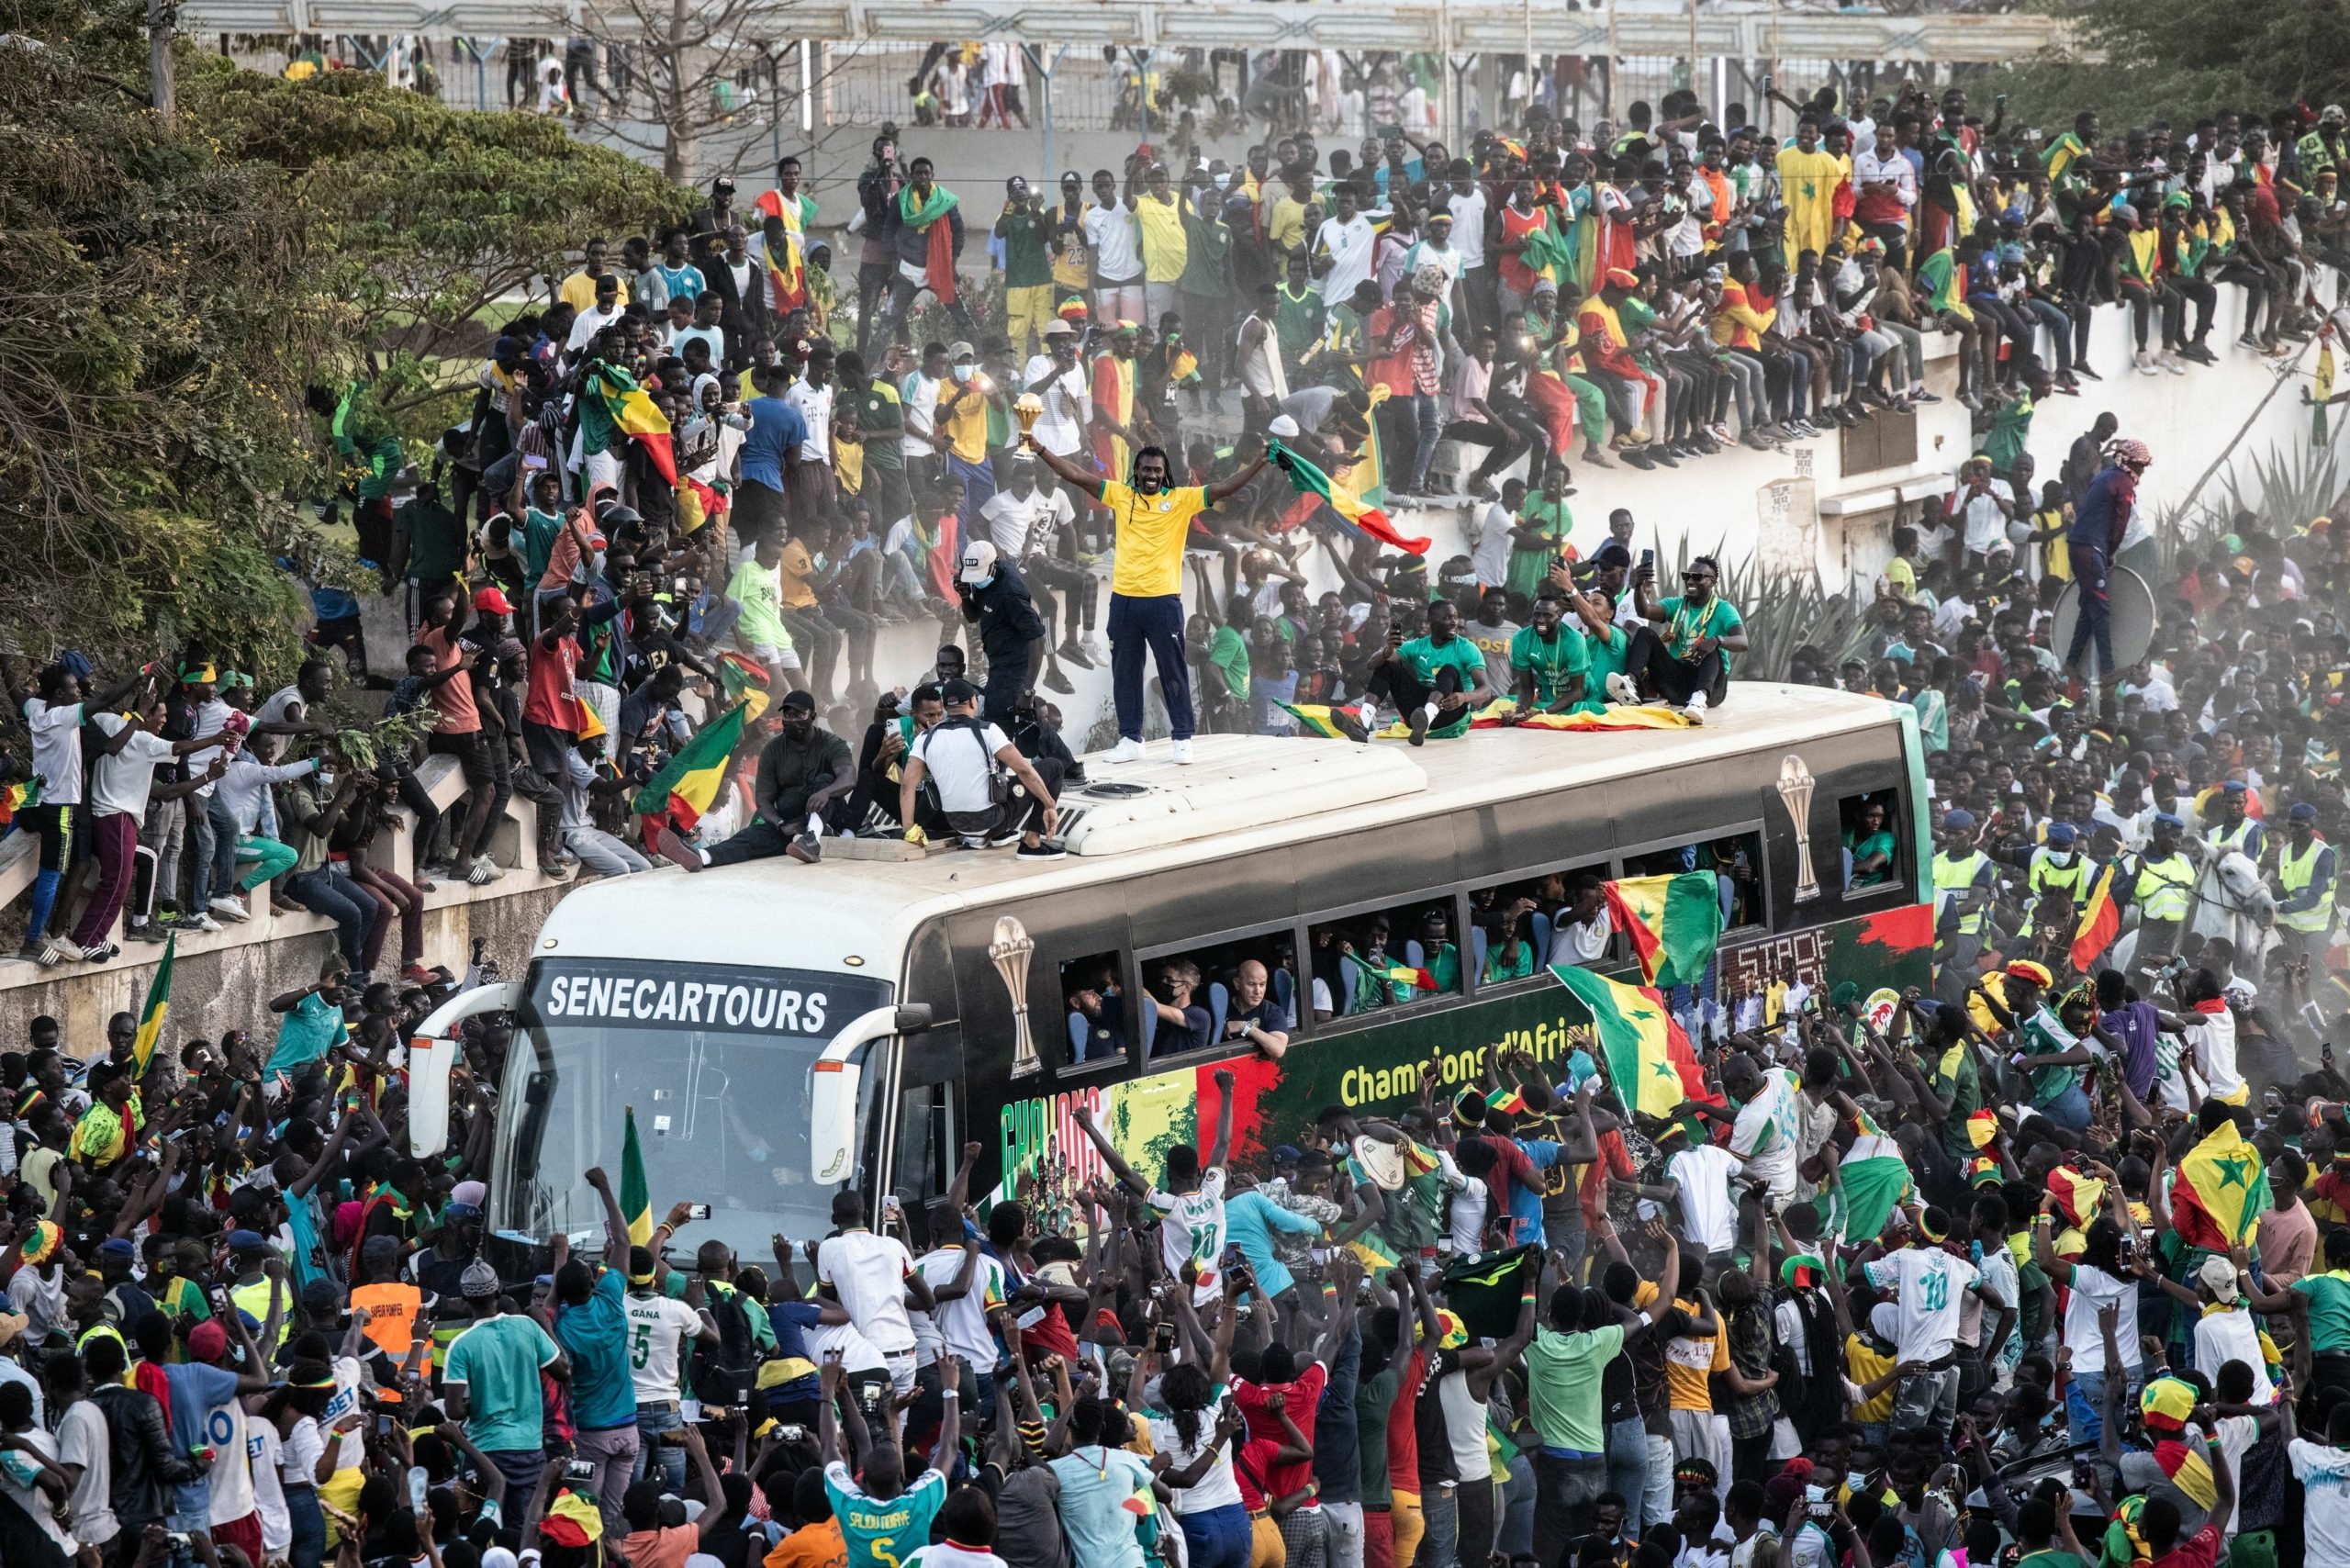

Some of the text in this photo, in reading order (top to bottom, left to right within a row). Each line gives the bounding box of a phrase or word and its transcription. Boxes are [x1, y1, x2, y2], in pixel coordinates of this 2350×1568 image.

[1069, 249, 1085, 265] 23
[547, 975, 827, 1034] SENECARTOURS
[1919, 1272, 1947, 1311] 10
[632, 1309, 660, 1319] GANA
[632, 1324, 652, 1370] 5
